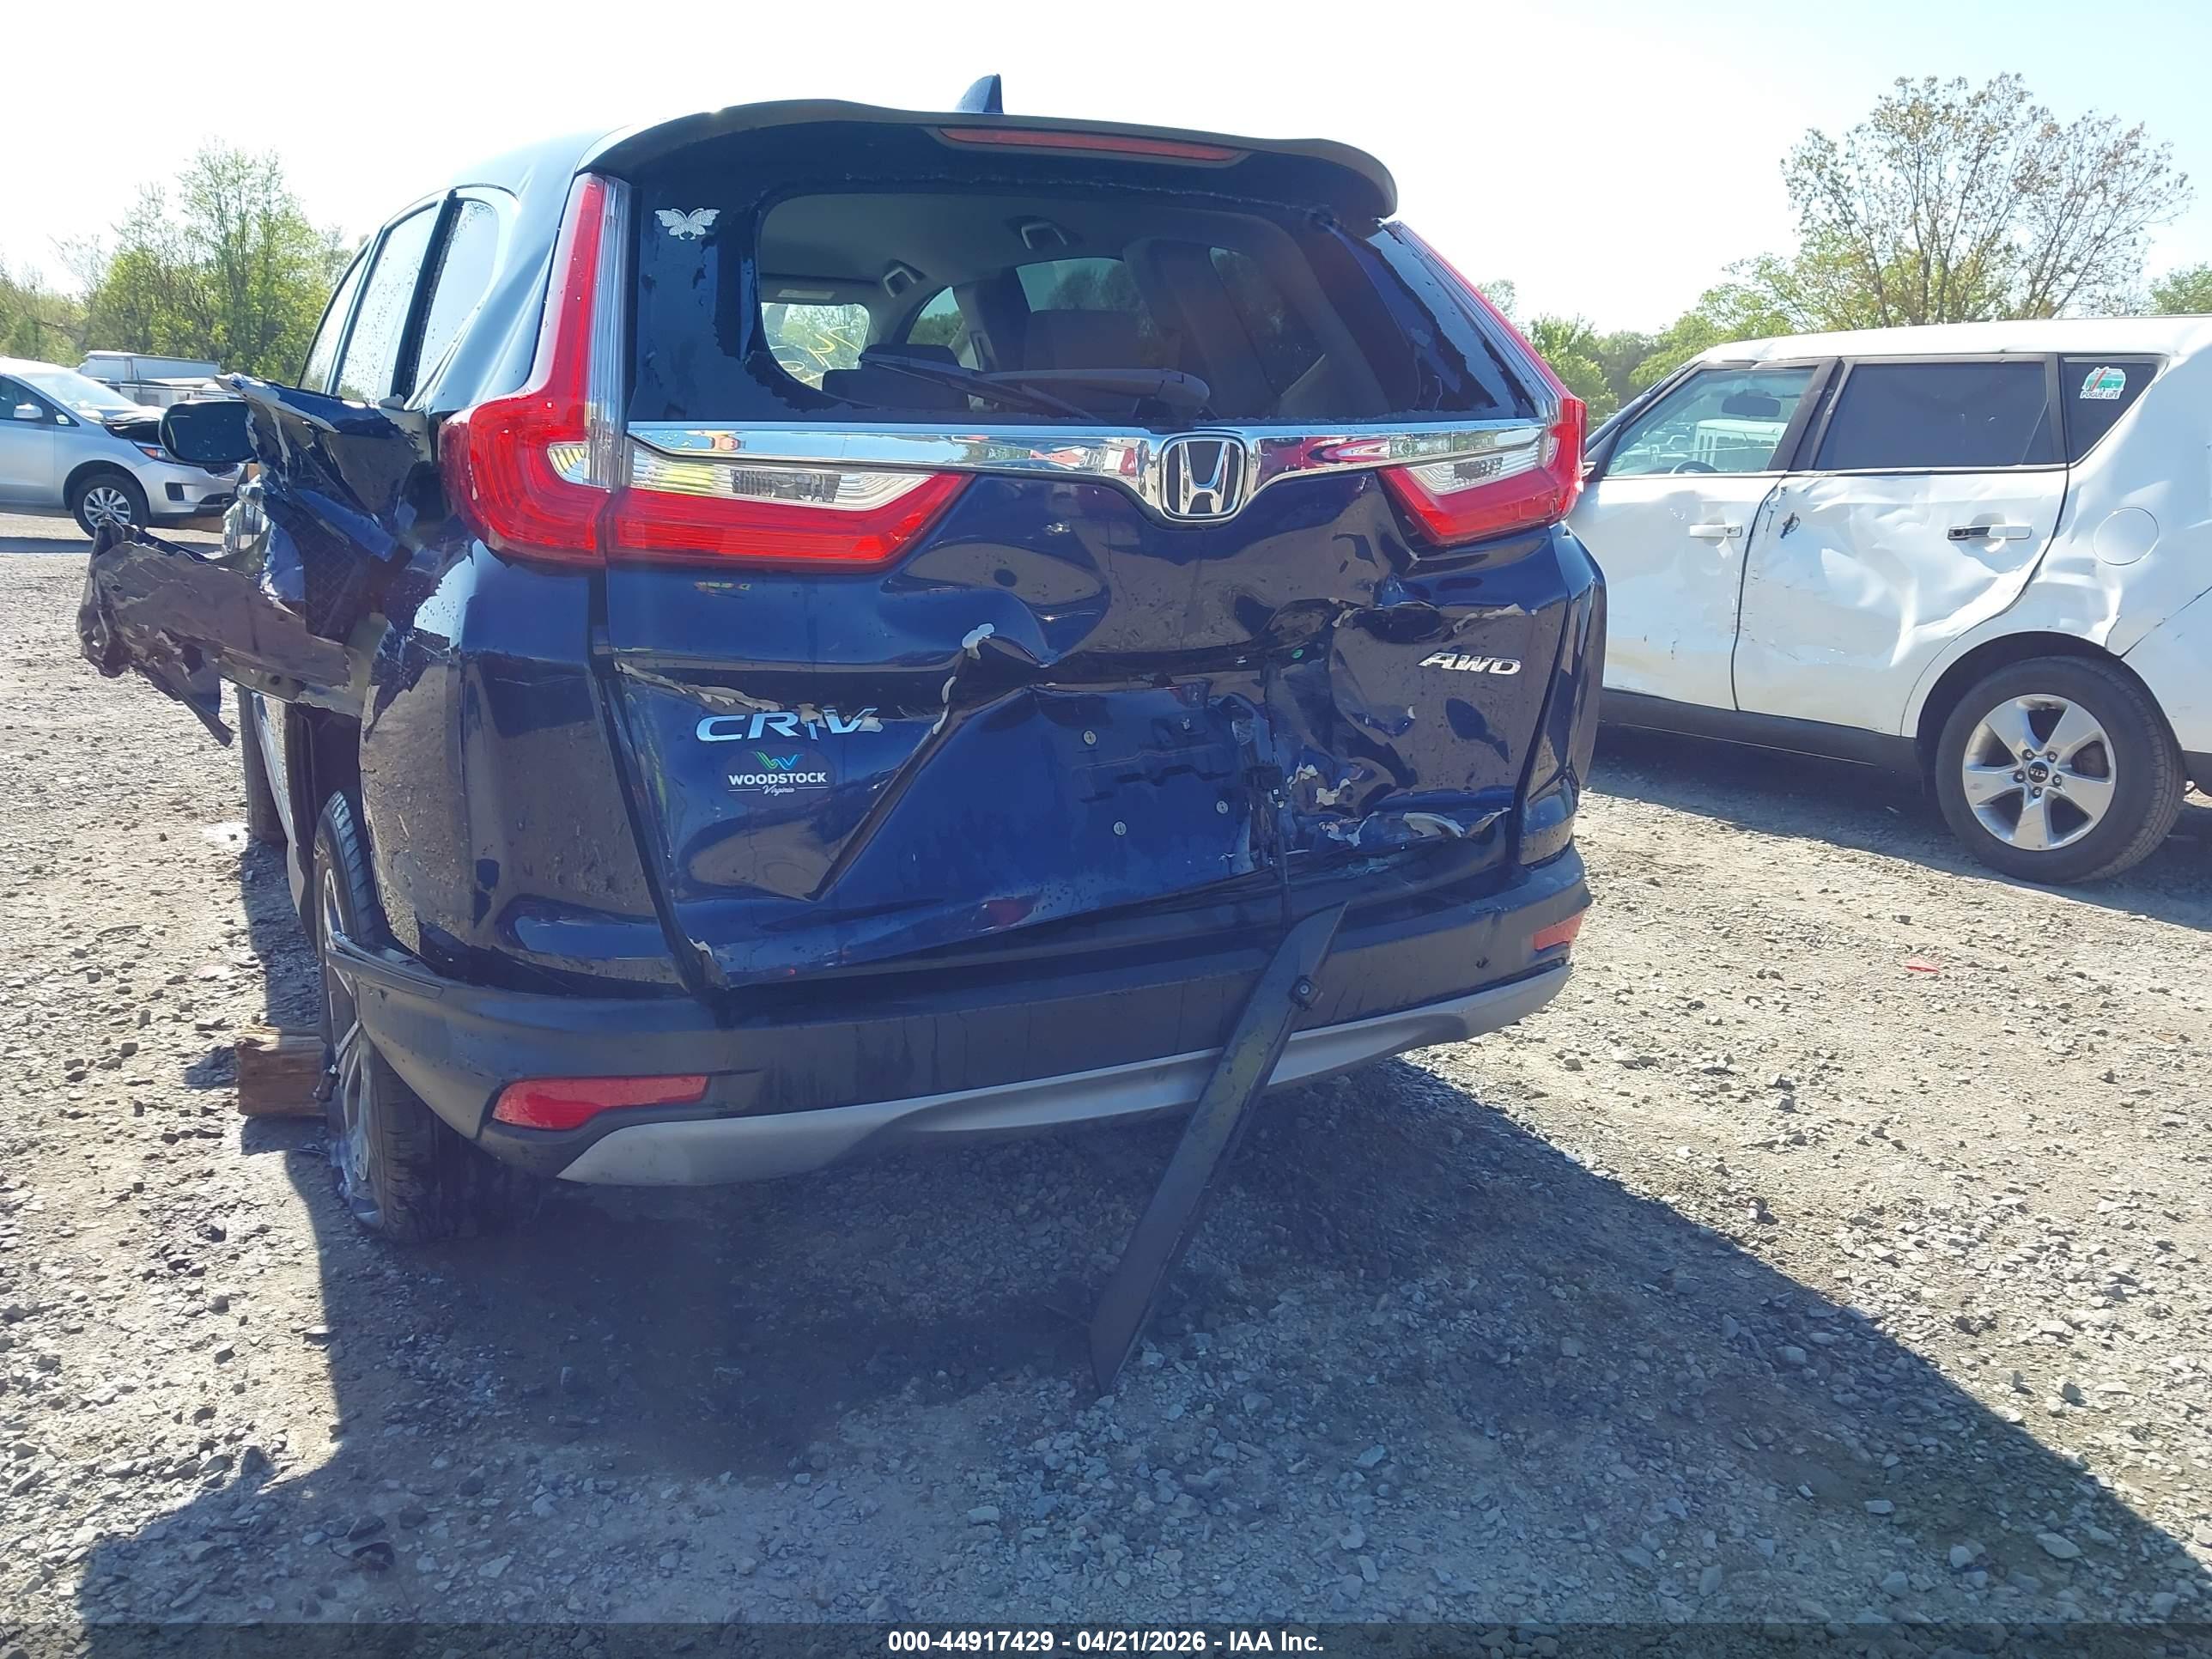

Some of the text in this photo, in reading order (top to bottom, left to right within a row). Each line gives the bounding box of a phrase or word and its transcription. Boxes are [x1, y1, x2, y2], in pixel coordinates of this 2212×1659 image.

[1417, 652, 1522, 675] AWD
[727, 772, 827, 786] WOODSTOCK
[762, 784, 795, 796] Virginia
